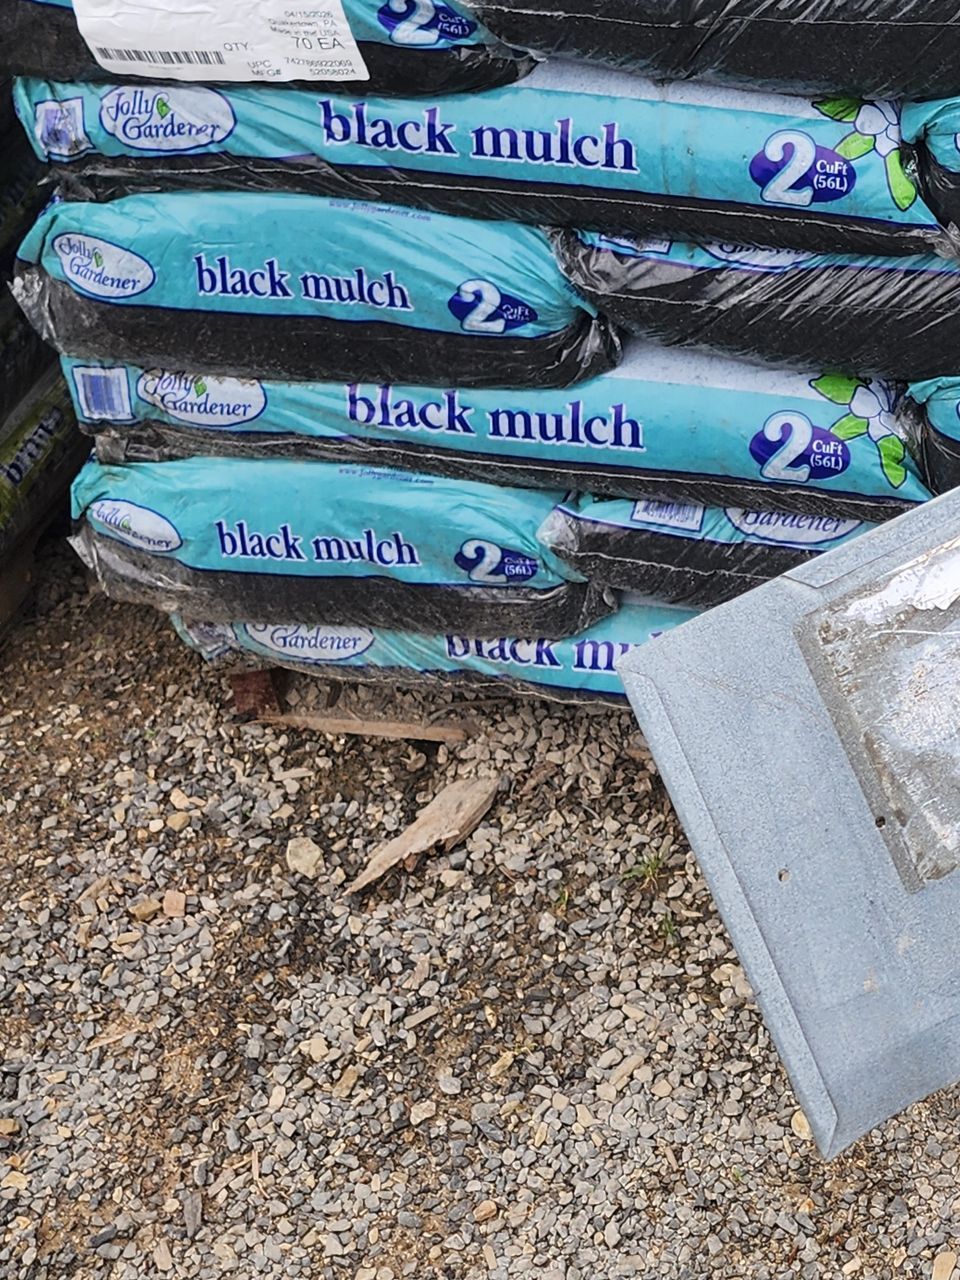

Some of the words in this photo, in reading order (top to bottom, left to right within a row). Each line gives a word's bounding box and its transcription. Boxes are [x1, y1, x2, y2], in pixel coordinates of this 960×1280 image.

[319, 29, 341, 38] USA
[323, 19, 338, 28] PA
[290, 35, 313, 50] 70
[316, 36, 346, 50] EA
[246, 59, 272, 70] UPC
[105, 89, 155, 121] Jolly
[121, 114, 222, 140] Gardener
[318, 99, 457, 155] black
[471, 116, 639, 174] mulch
[760, 129, 816, 208] 2
[815, 159, 849, 176] CuFt
[813, 175, 849, 193] (56L)
[57, 236, 95, 258] Jolly
[69, 255, 142, 292] Gardener
[193, 253, 295, 299] black
[299, 265, 414, 312] mulch
[458, 278, 506, 334] 2
[144, 369, 195, 398] Jolly
[160, 392, 252, 418] Gardener
[346, 383, 476, 435] black
[486, 399, 647, 450] mulch
[760, 410, 813, 483] 2
[812, 439, 843, 455] CuFt
[810, 454, 843, 471] (56L)
[215, 519, 307, 561] black
[312, 530, 420, 567] mulch
[460, 538, 508, 584] 2
[504, 564, 534, 577] (56L)
[270, 627, 363, 651] Gardener
